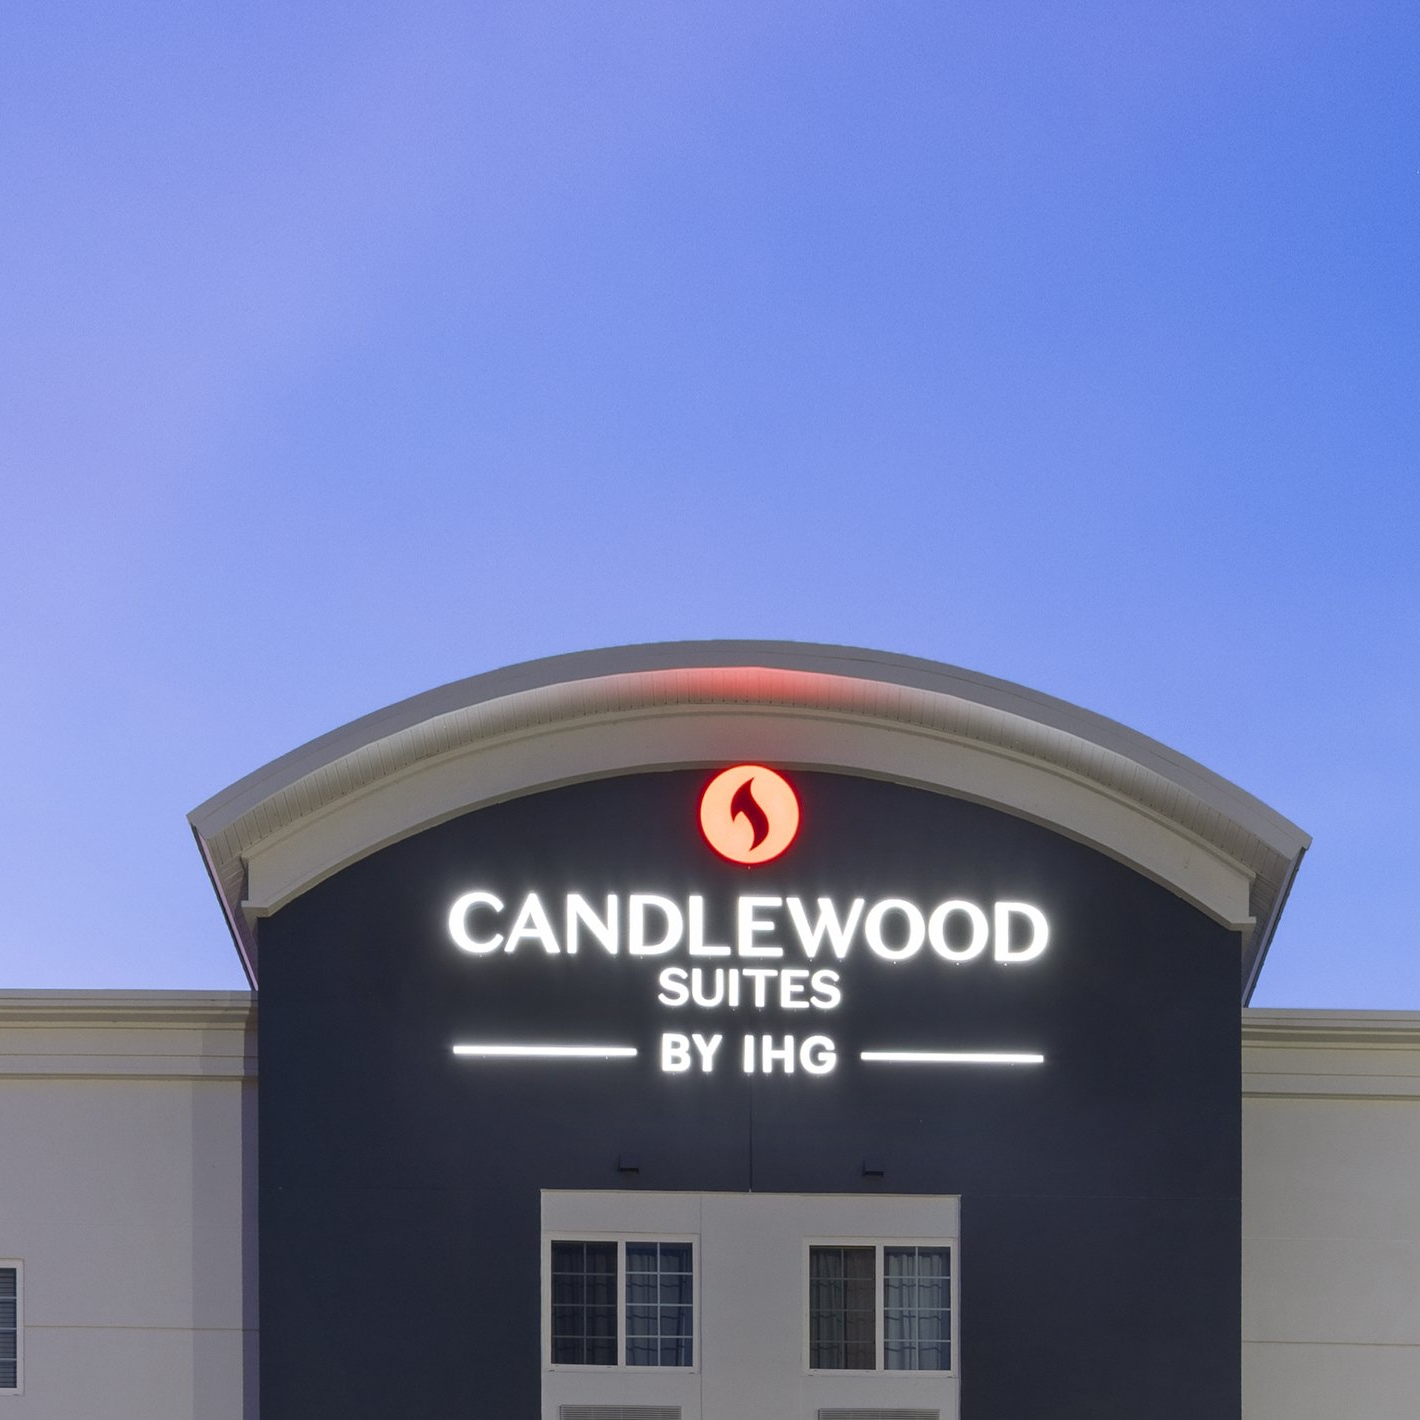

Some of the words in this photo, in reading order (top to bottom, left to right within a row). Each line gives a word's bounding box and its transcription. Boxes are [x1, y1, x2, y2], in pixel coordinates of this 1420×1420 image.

[447, 890, 1051, 963] CANDLEWOOD
[657, 966, 842, 1010] SUITES
[660, 1032, 723, 1074] BY
[742, 1034, 838, 1075] IHG
